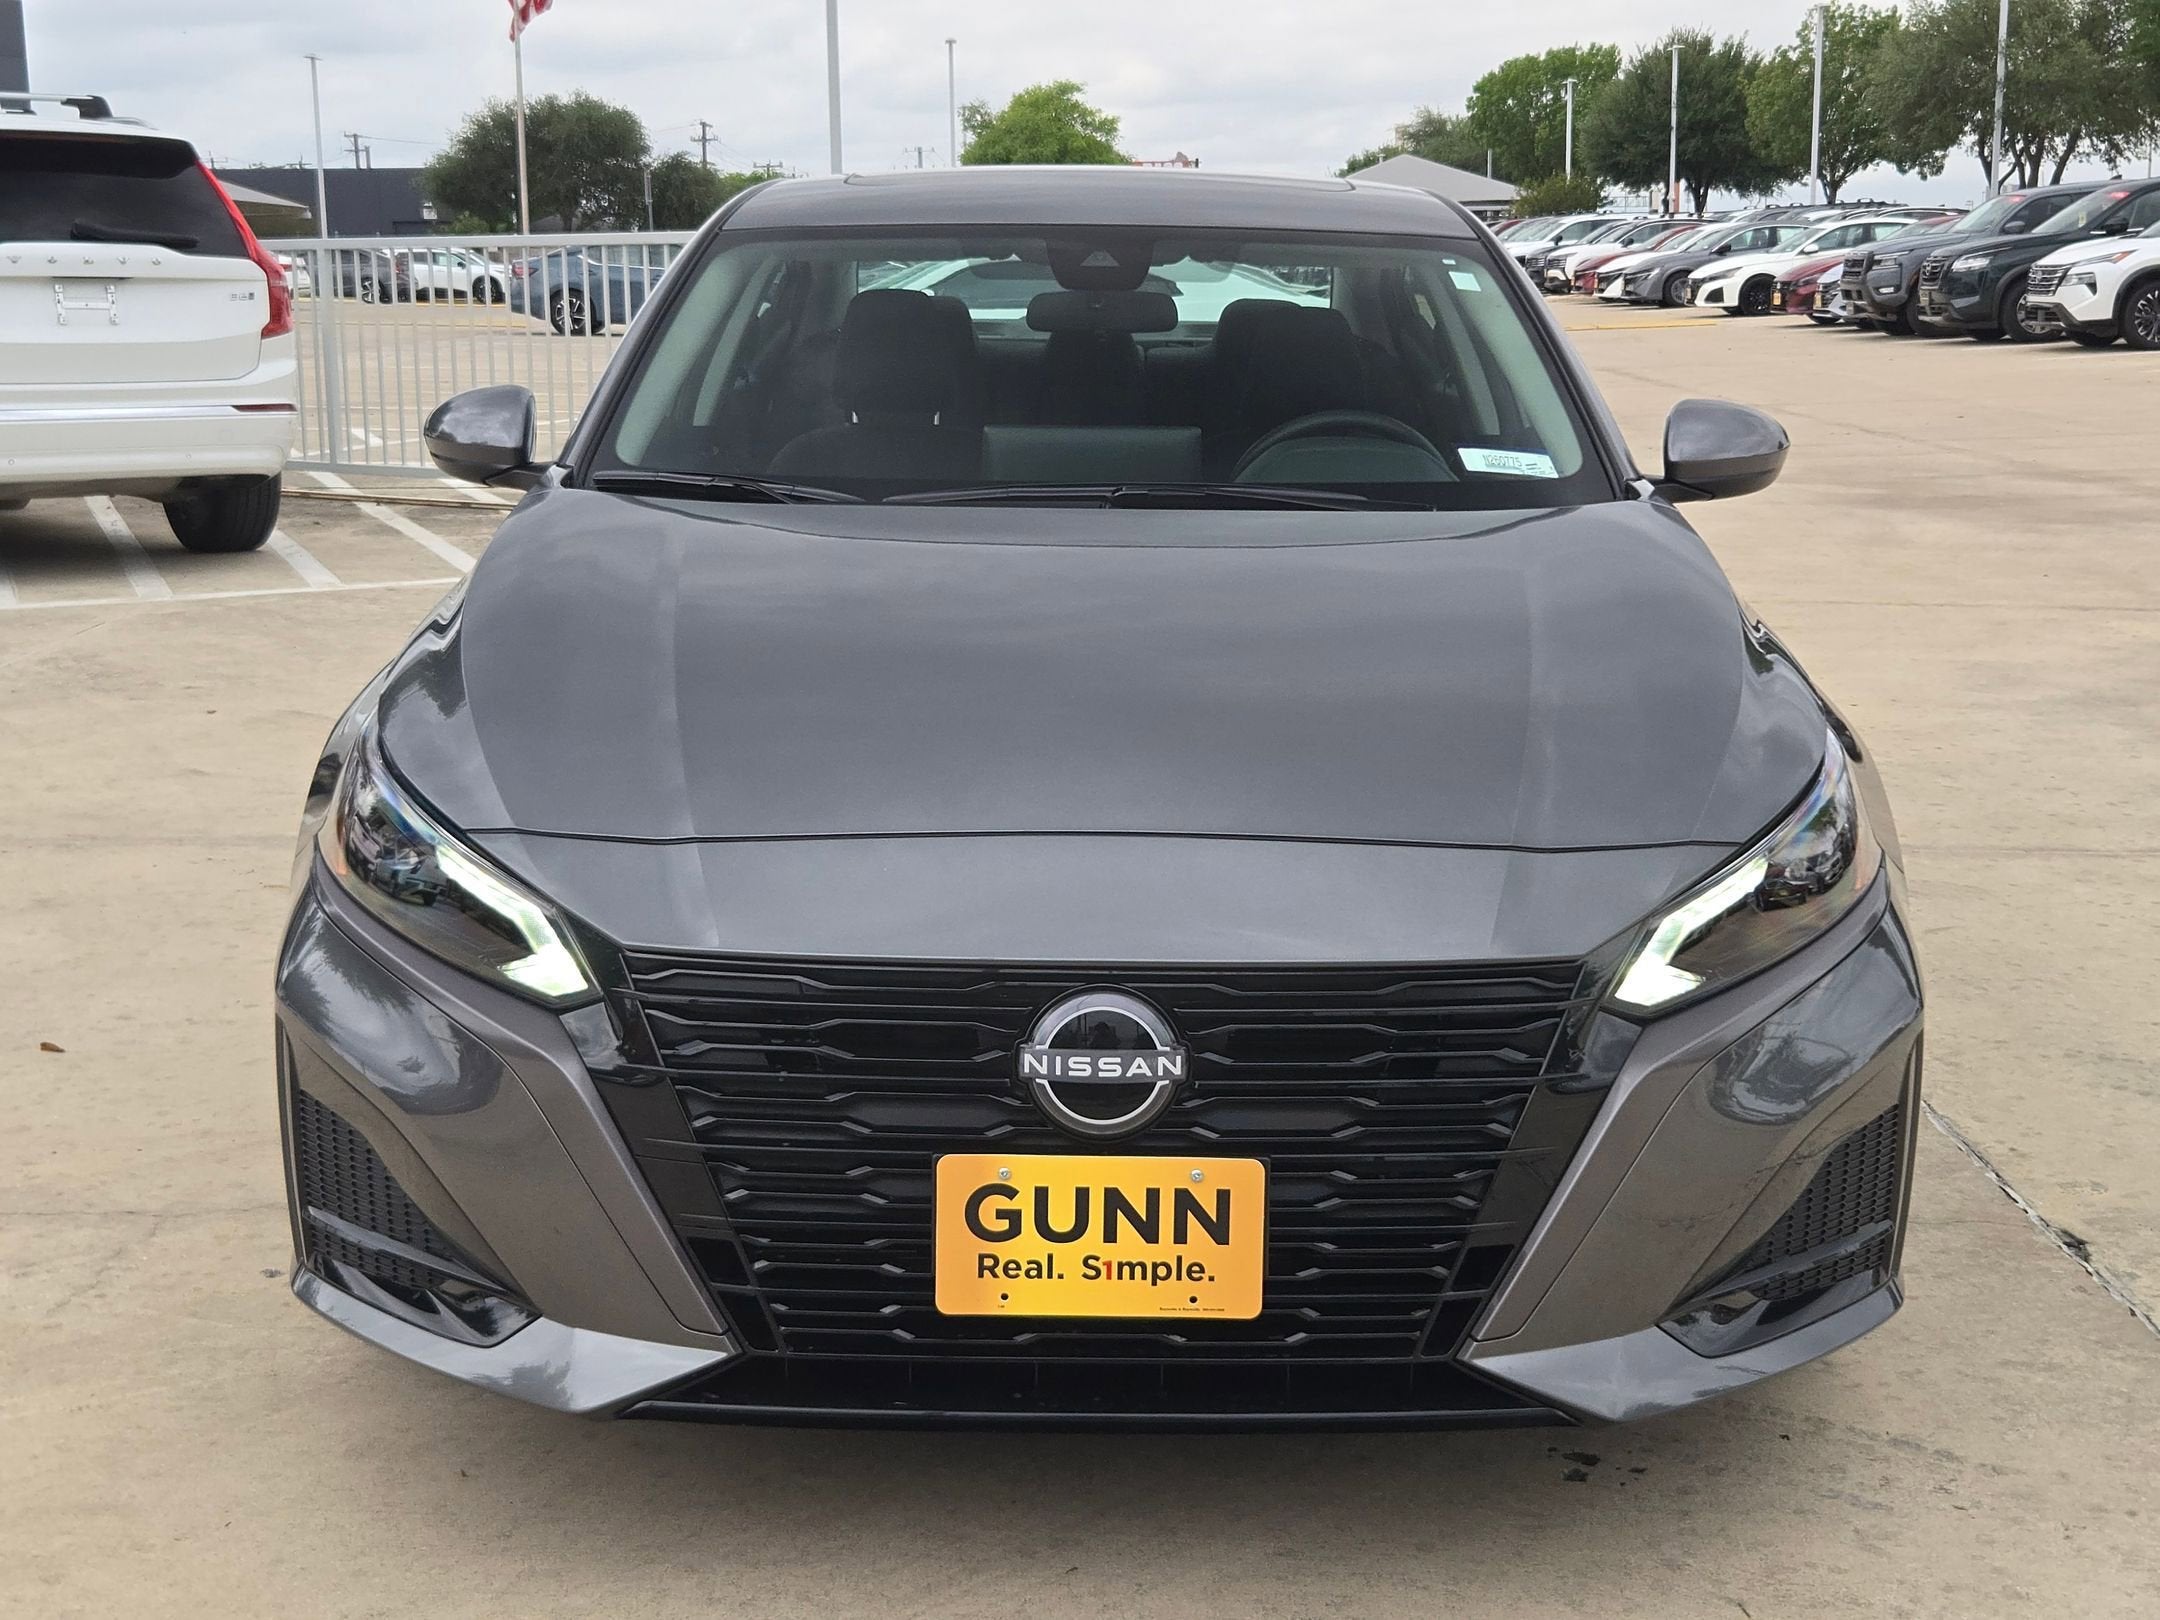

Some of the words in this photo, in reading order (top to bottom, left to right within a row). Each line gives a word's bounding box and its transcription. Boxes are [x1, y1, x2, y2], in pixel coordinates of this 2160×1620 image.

[1023, 1053, 1182, 1077] NISSAN
[964, 1183, 1231, 1246] GUNN
[977, 1253, 1064, 1280] Real.
